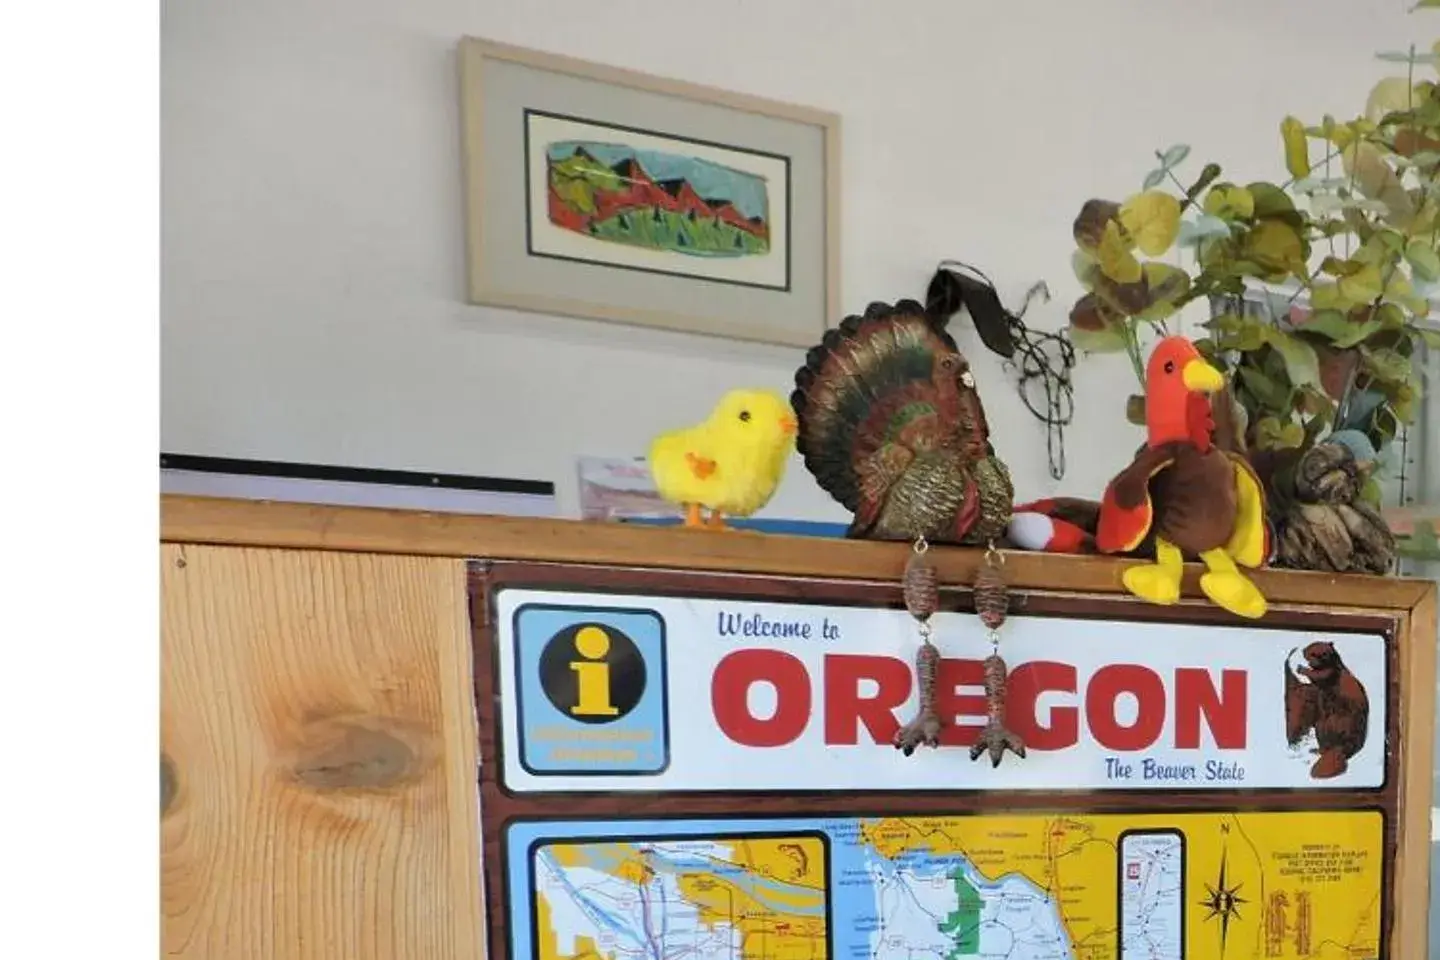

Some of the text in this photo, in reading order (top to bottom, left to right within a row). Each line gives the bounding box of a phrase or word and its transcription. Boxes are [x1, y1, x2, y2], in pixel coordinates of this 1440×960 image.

[718, 610, 841, 640] Welcome to
[711, 647, 1248, 751] OREGON
[1105, 757, 1246, 780] The Beaver State
